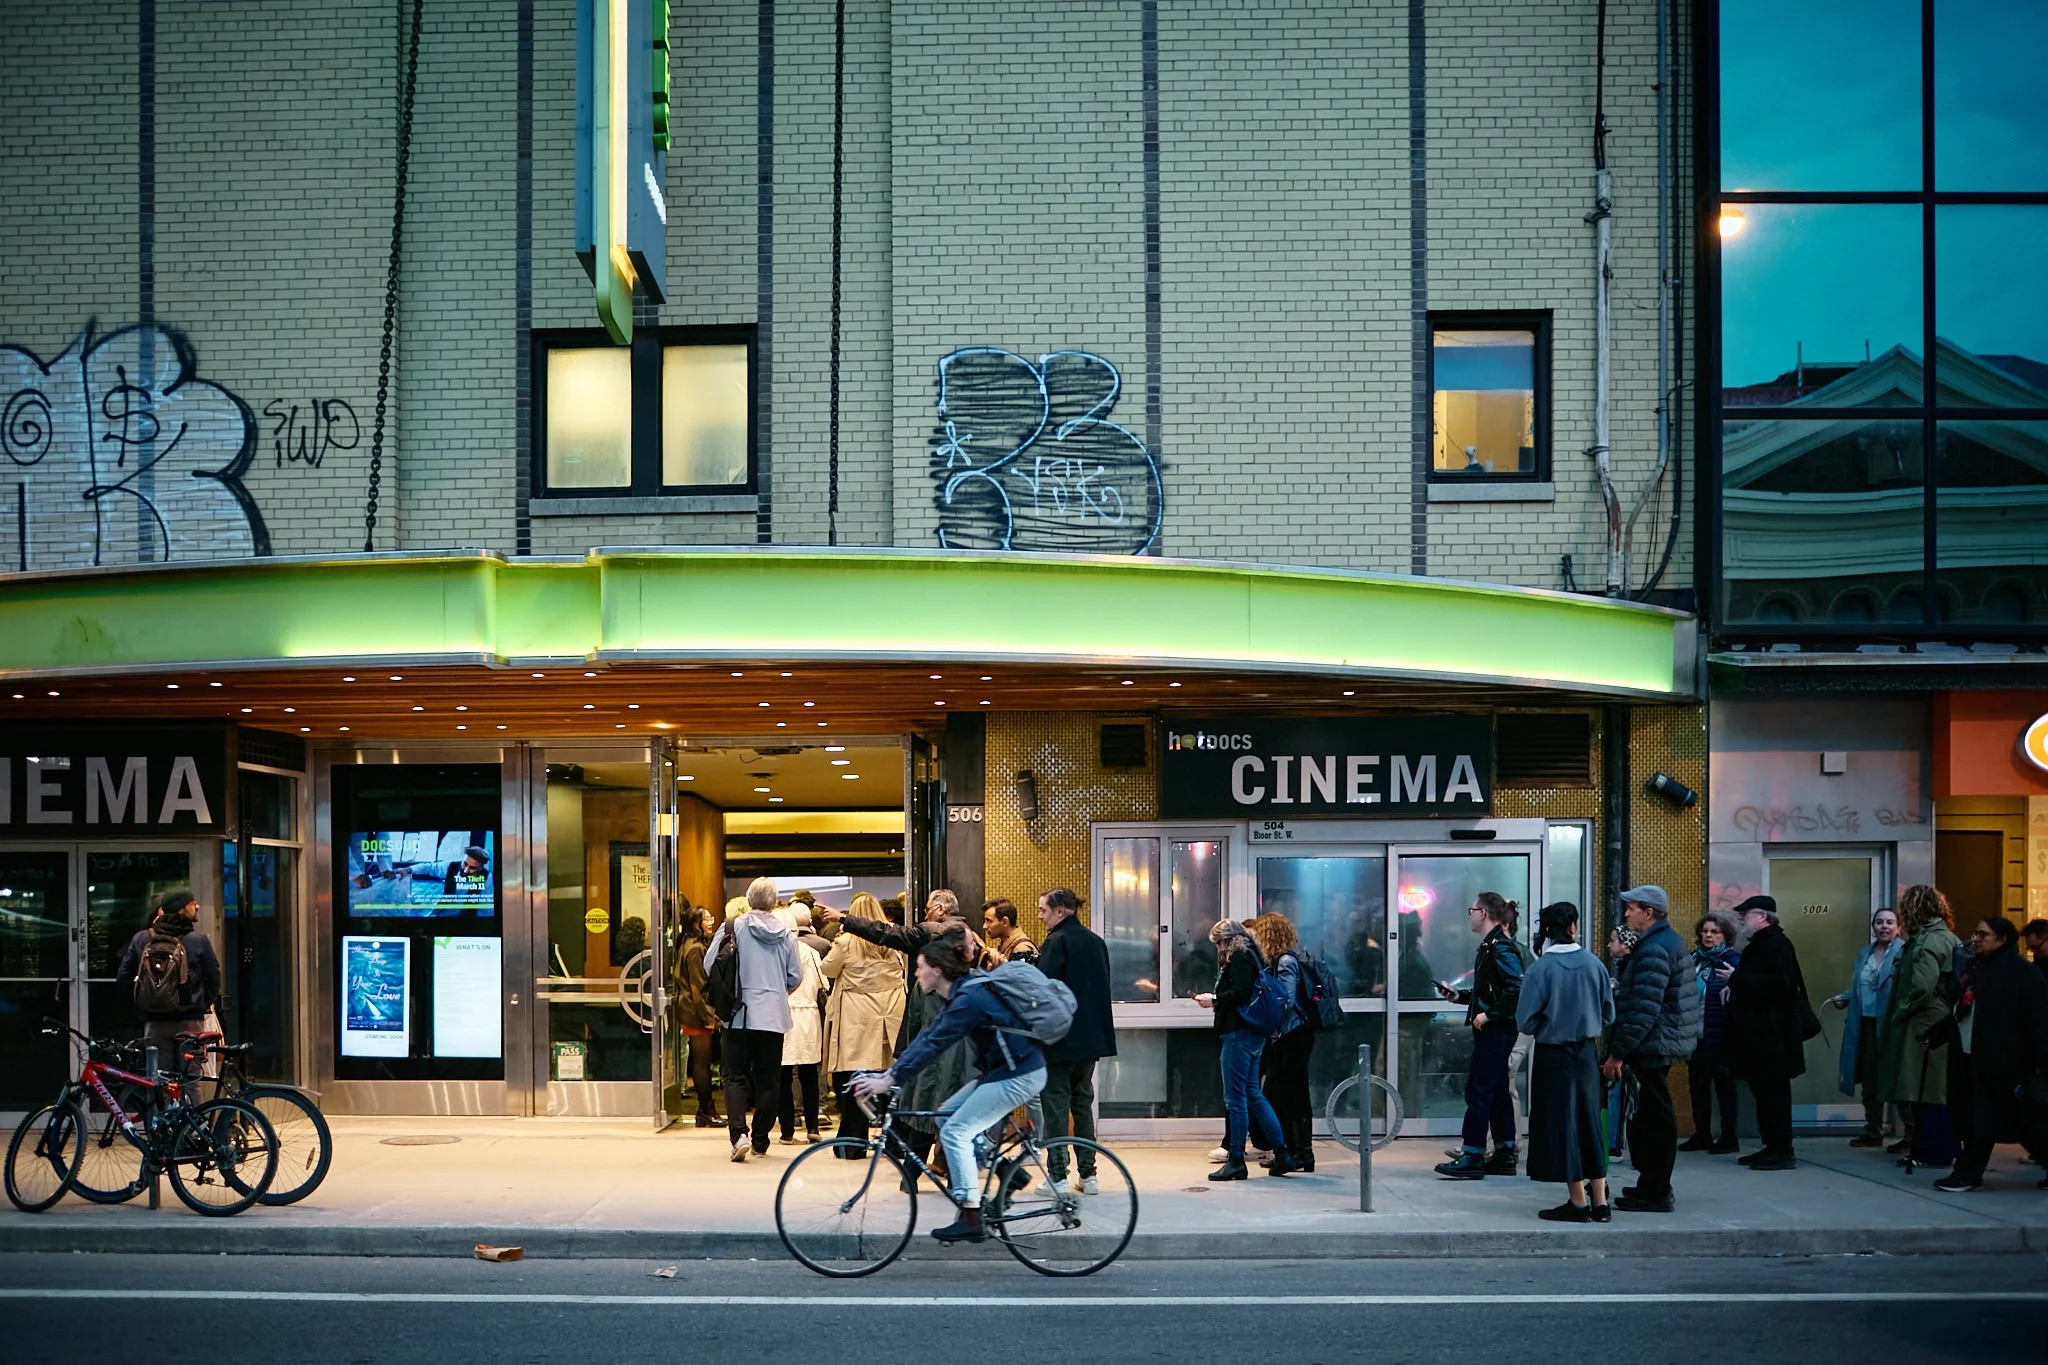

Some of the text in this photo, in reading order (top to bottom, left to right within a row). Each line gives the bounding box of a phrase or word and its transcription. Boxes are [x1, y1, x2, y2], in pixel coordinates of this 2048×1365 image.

[1231, 755, 1484, 805] CINEMA
[0, 756, 213, 824] EMA
[949, 807, 983, 823] 506
[1264, 821, 1284, 830] 504
[632, 864, 646, 874] The
[454, 875, 485, 883] The Theft
[1803, 905, 1828, 914] 500A
[352, 976, 373, 990] Your
[373, 983, 401, 1000] Love
[560, 1047, 580, 1056] PASS
